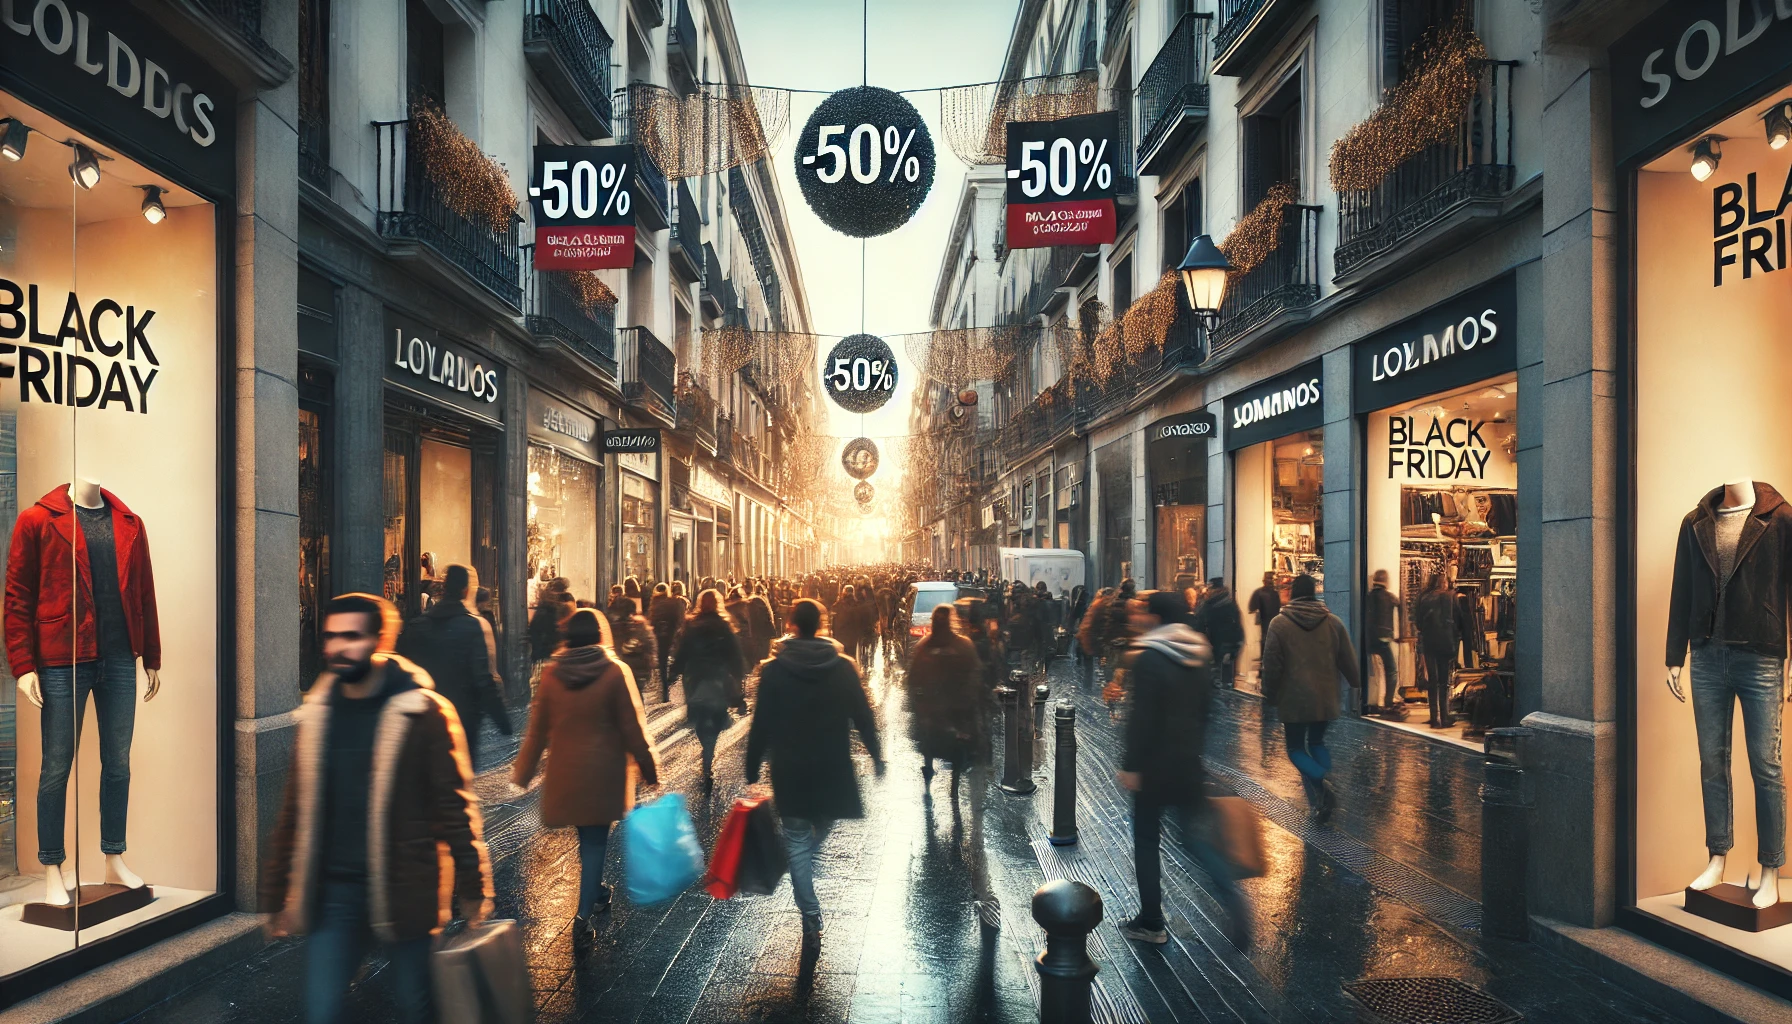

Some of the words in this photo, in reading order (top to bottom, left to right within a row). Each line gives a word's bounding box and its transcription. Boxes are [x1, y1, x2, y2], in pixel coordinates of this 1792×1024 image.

[802, 123, 920, 184] -50%
[1007, 137, 1112, 197] -50%
[529, 160, 631, 219] -50%
[0, 278, 160, 366] BLACK
[825, 356, 893, 392] -50%
[1389, 414, 1487, 448] BLACK
[1388, 447, 1491, 480] FRIDAY
